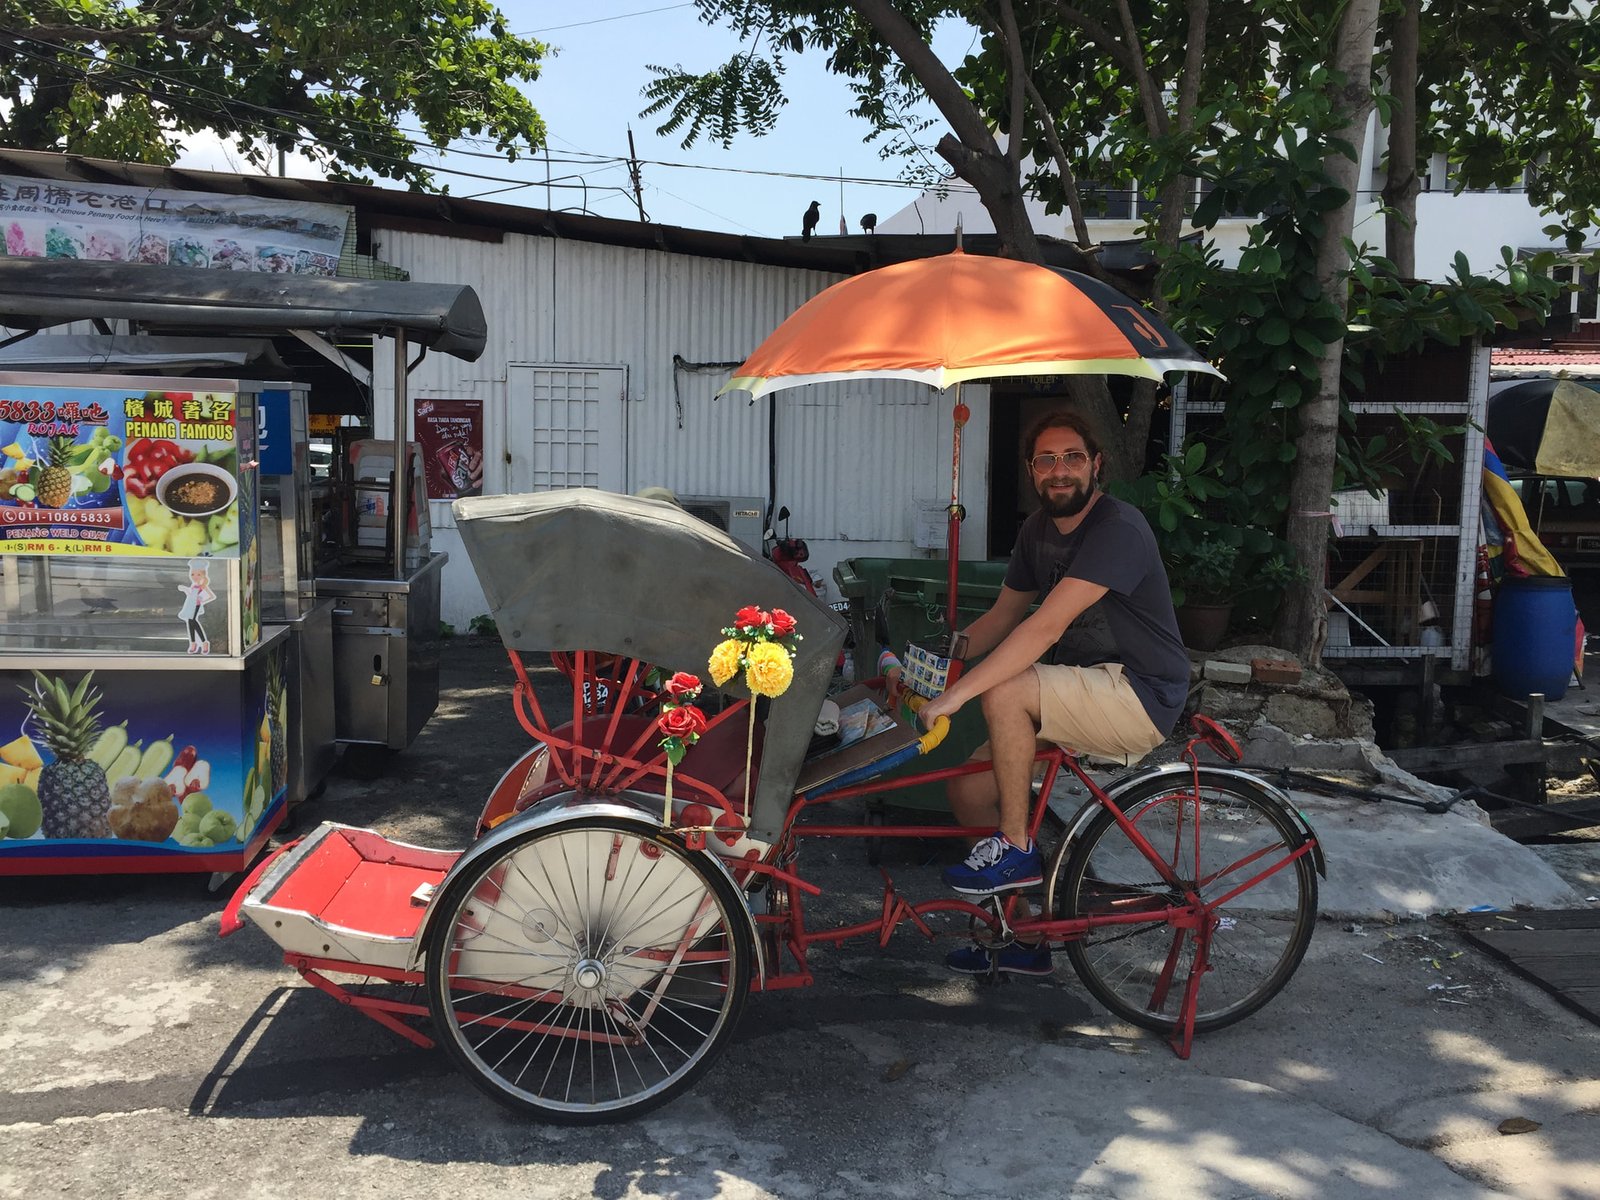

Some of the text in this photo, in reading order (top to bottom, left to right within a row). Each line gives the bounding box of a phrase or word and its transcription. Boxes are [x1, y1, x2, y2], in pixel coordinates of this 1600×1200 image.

[43, 206, 56, 214] The
[57, 207, 86, 216] Famous
[87, 210, 115, 220] Penang
[115, 213, 135, 221] Food
[27, 423, 79, 437] ROJAK
[125, 421, 233, 440] PENANG FAMOUS
[18, 511, 111, 523] 011-1086 5833
[6, 528, 109, 540] PENANG WELD QUAY
[105, 544, 112, 552] 8
